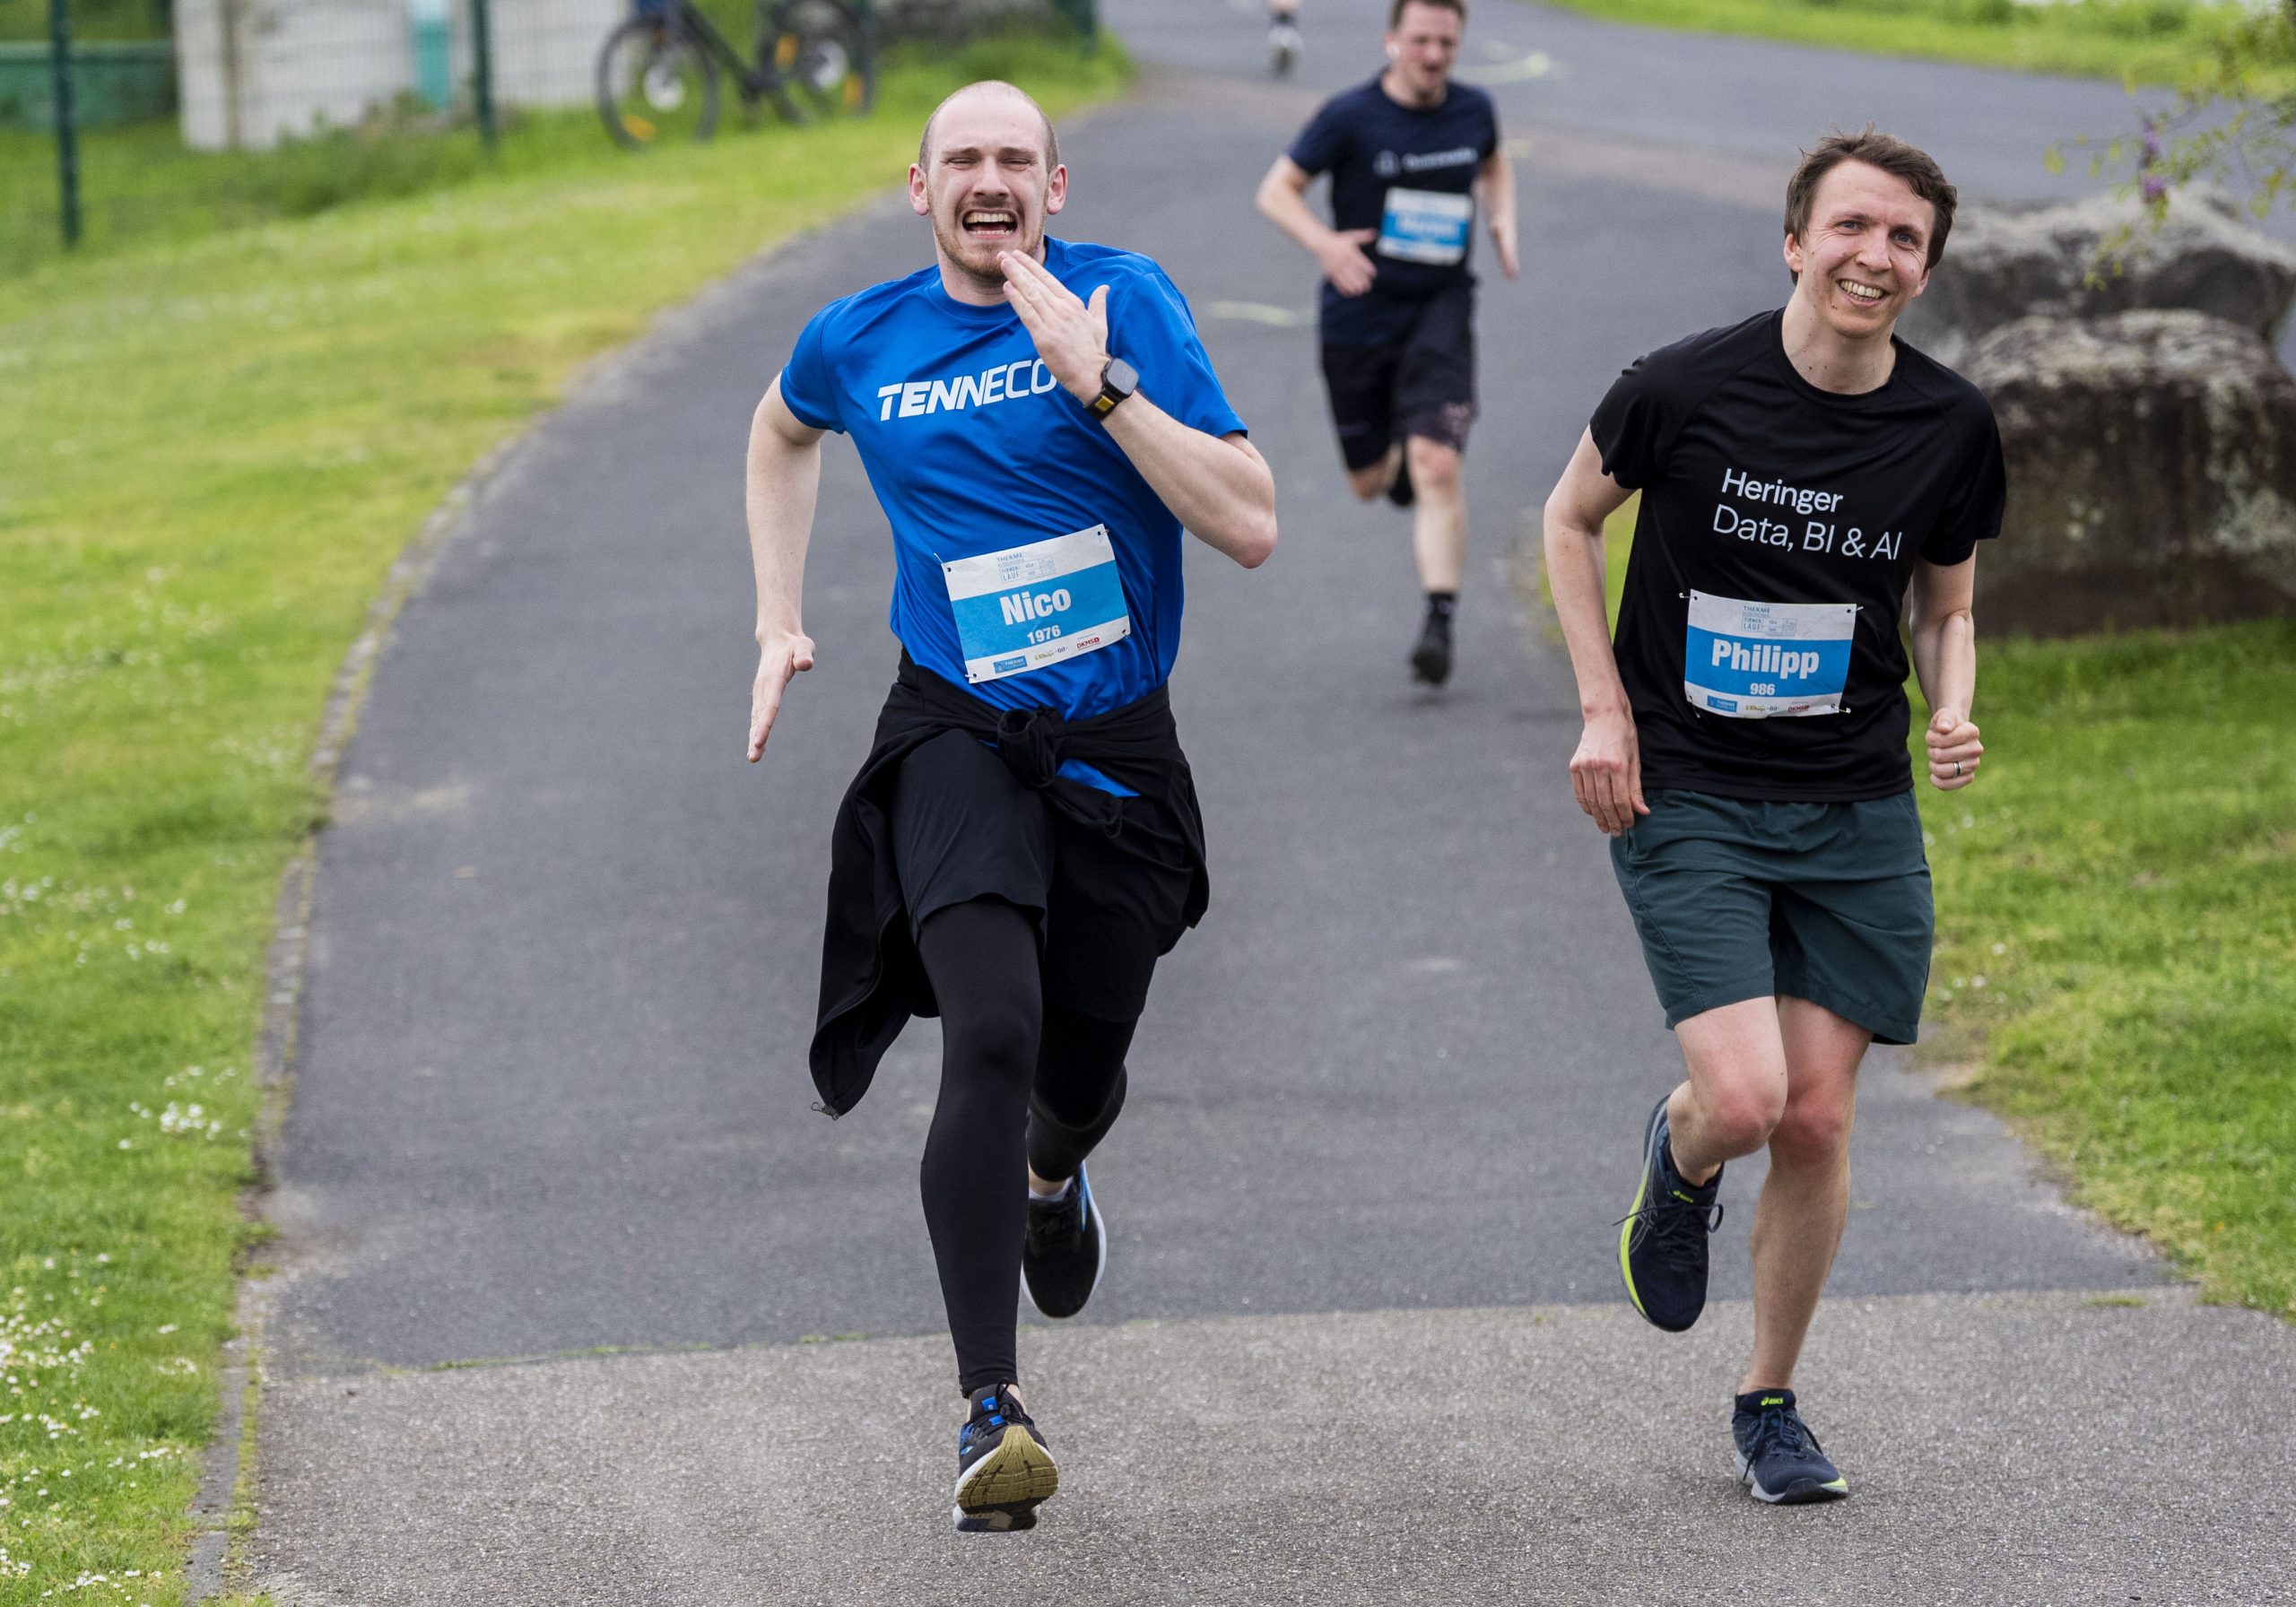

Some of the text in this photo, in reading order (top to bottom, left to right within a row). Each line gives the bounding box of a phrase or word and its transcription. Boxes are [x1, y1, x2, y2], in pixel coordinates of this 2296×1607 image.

[877, 358, 1057, 421] TENNECO
[1721, 468, 1843, 515] Heringer
[1713, 504, 1902, 560] Data, BI & AI
[999, 588, 1073, 626] Nico
[1027, 625, 1061, 645] 1976
[1711, 638, 1820, 680] Philipp
[1750, 682, 1776, 696] 986
